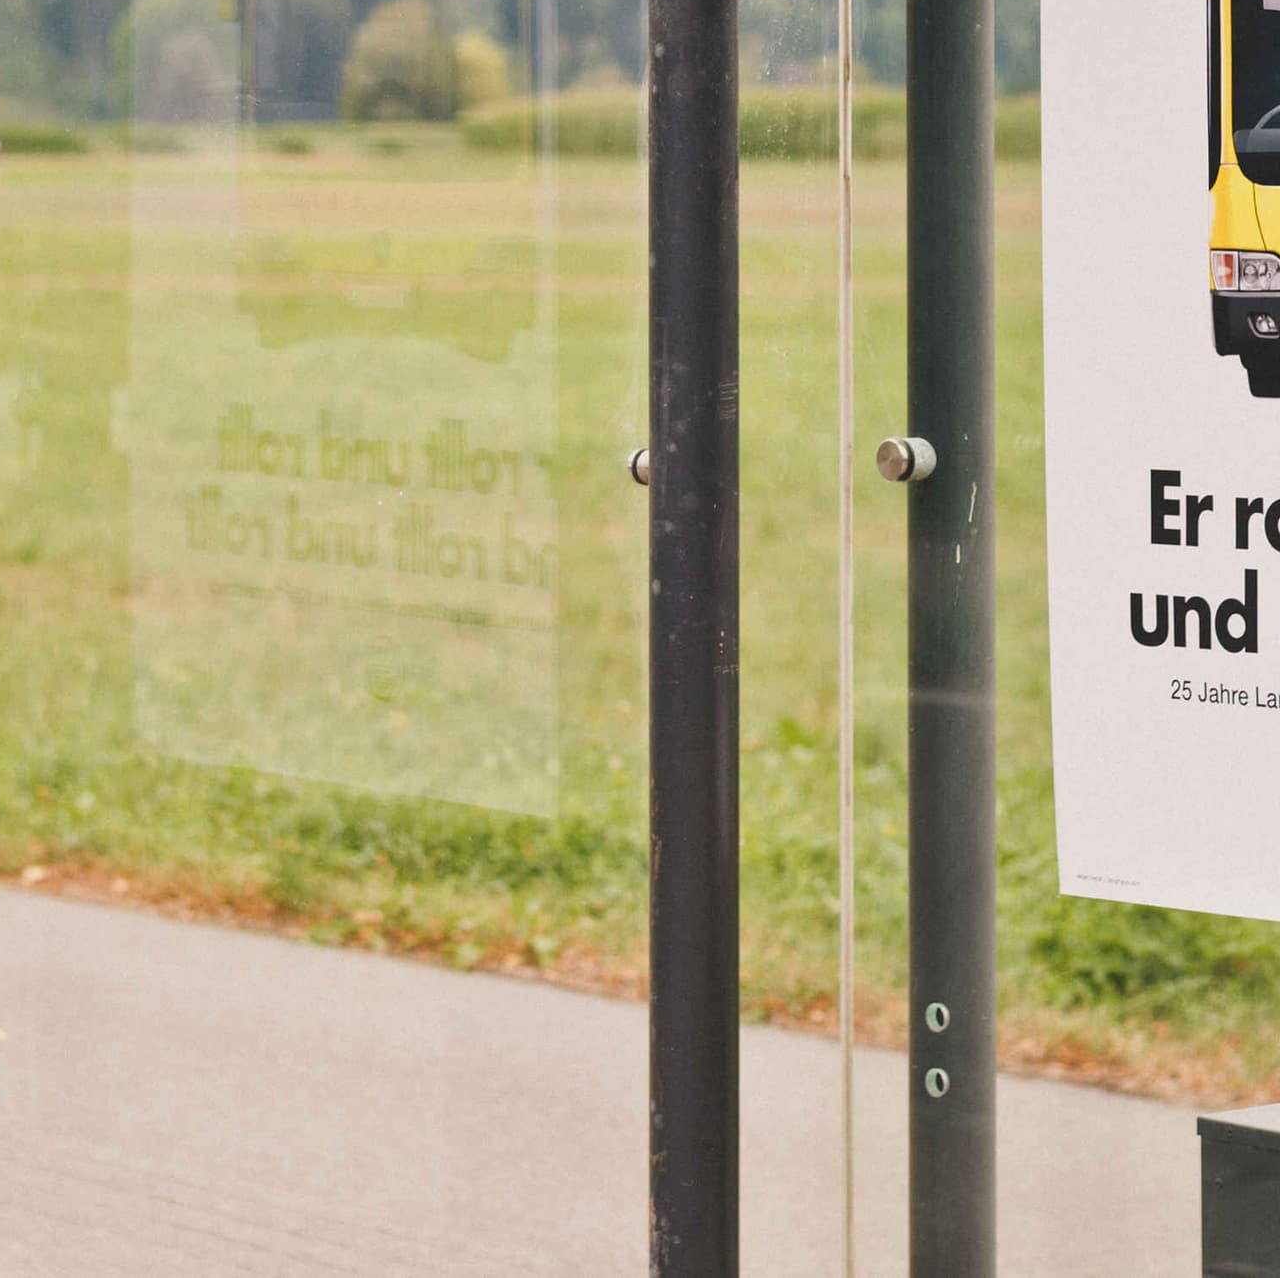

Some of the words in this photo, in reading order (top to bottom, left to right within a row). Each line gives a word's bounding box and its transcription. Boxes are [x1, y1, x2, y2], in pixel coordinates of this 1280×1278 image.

[1150, 469, 1213, 547] Er
[1129, 568, 1258, 654] und
[1171, 679, 1192, 701] 25
[1198, 682, 1249, 706] Jahre
